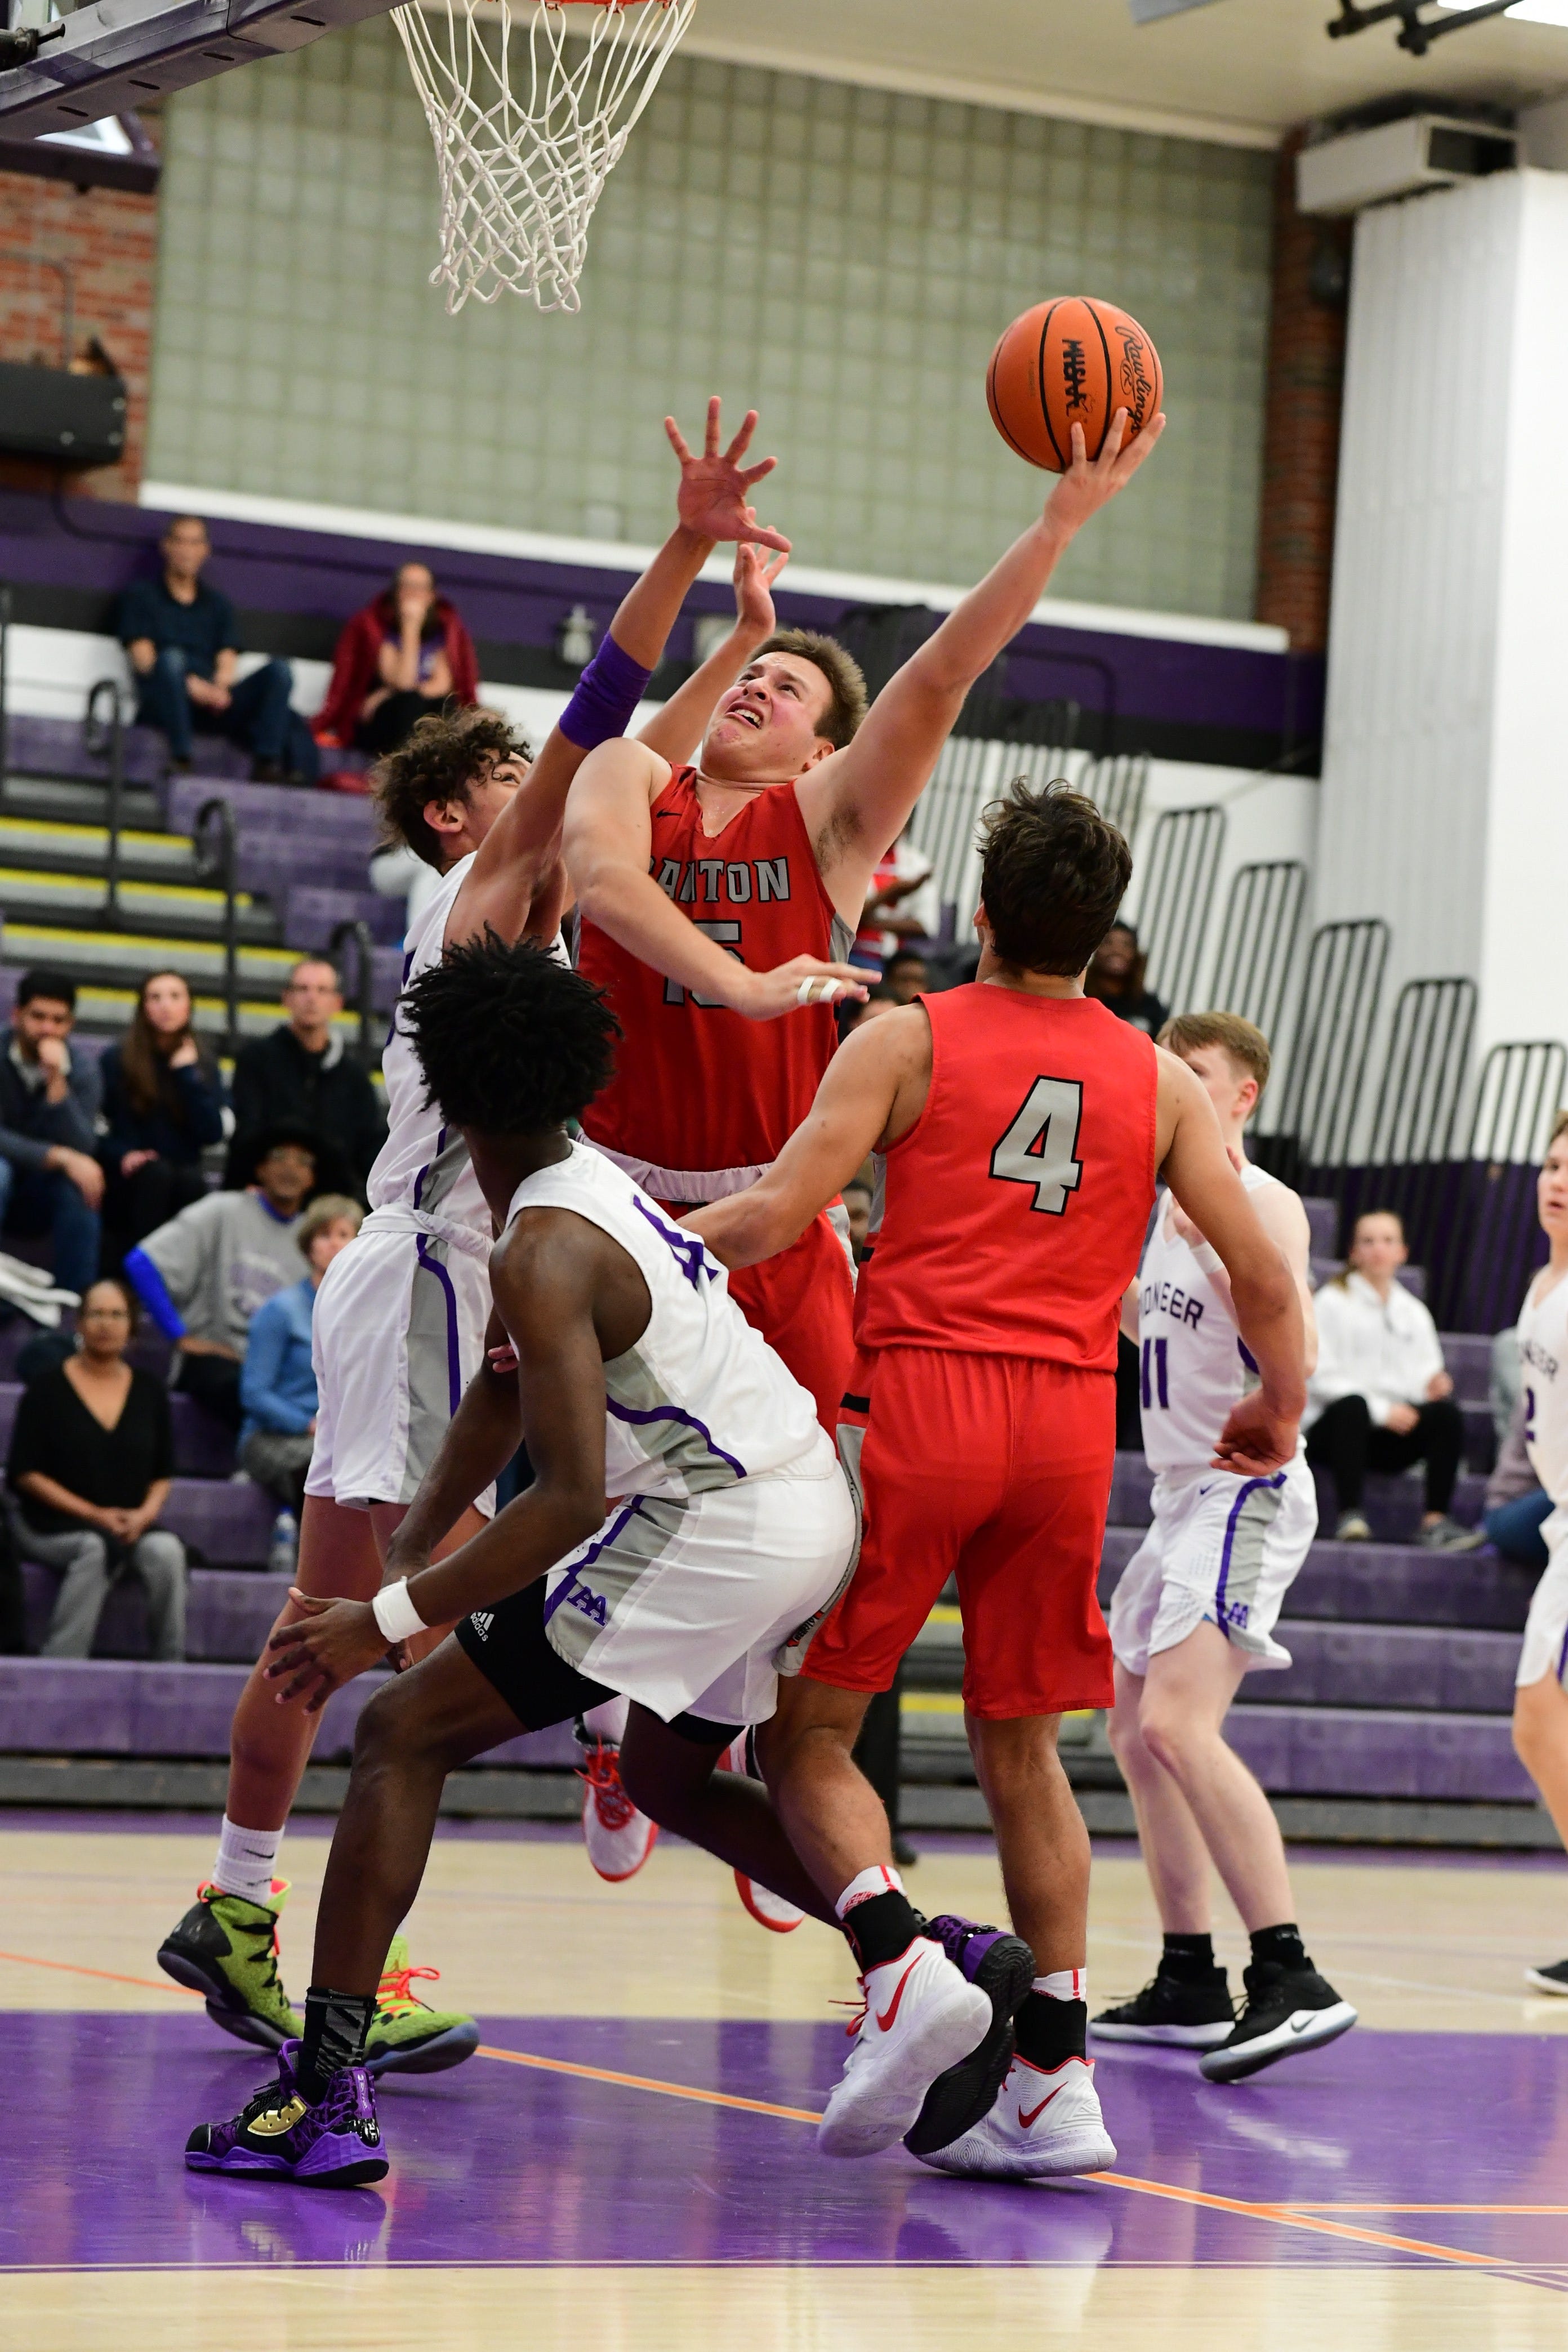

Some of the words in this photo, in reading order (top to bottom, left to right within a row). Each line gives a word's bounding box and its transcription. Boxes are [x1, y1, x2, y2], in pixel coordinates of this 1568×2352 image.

[1115, 326, 1152, 434] Rawlings
[649, 856, 790, 903] ANTON
[988, 1074, 1084, 1217] 4
[1142, 1337, 1169, 1410] 11
[470, 1612, 489, 1642] adidas
